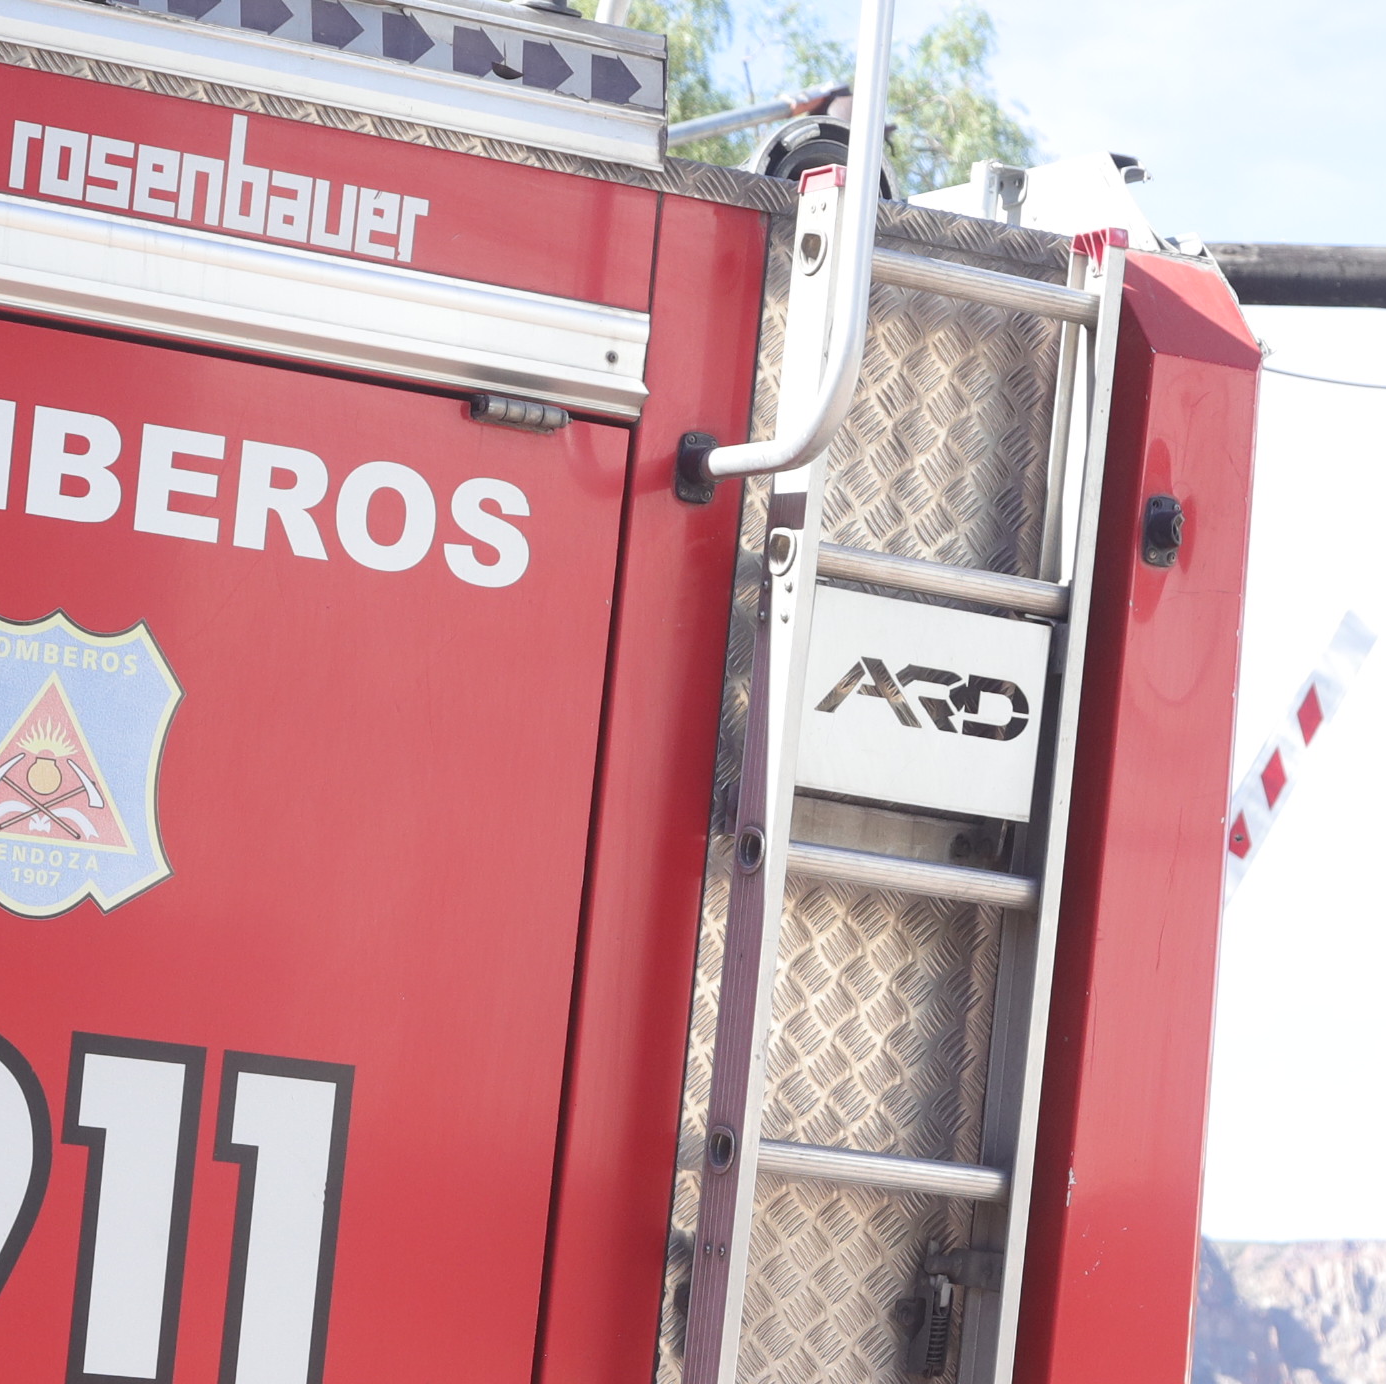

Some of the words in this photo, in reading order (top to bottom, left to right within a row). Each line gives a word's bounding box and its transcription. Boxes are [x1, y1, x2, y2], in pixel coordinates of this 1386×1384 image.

[9, 113, 430, 263] rosenbauer
[814, 656, 1030, 742] ARD
[10, 867, 62, 887] 1907
